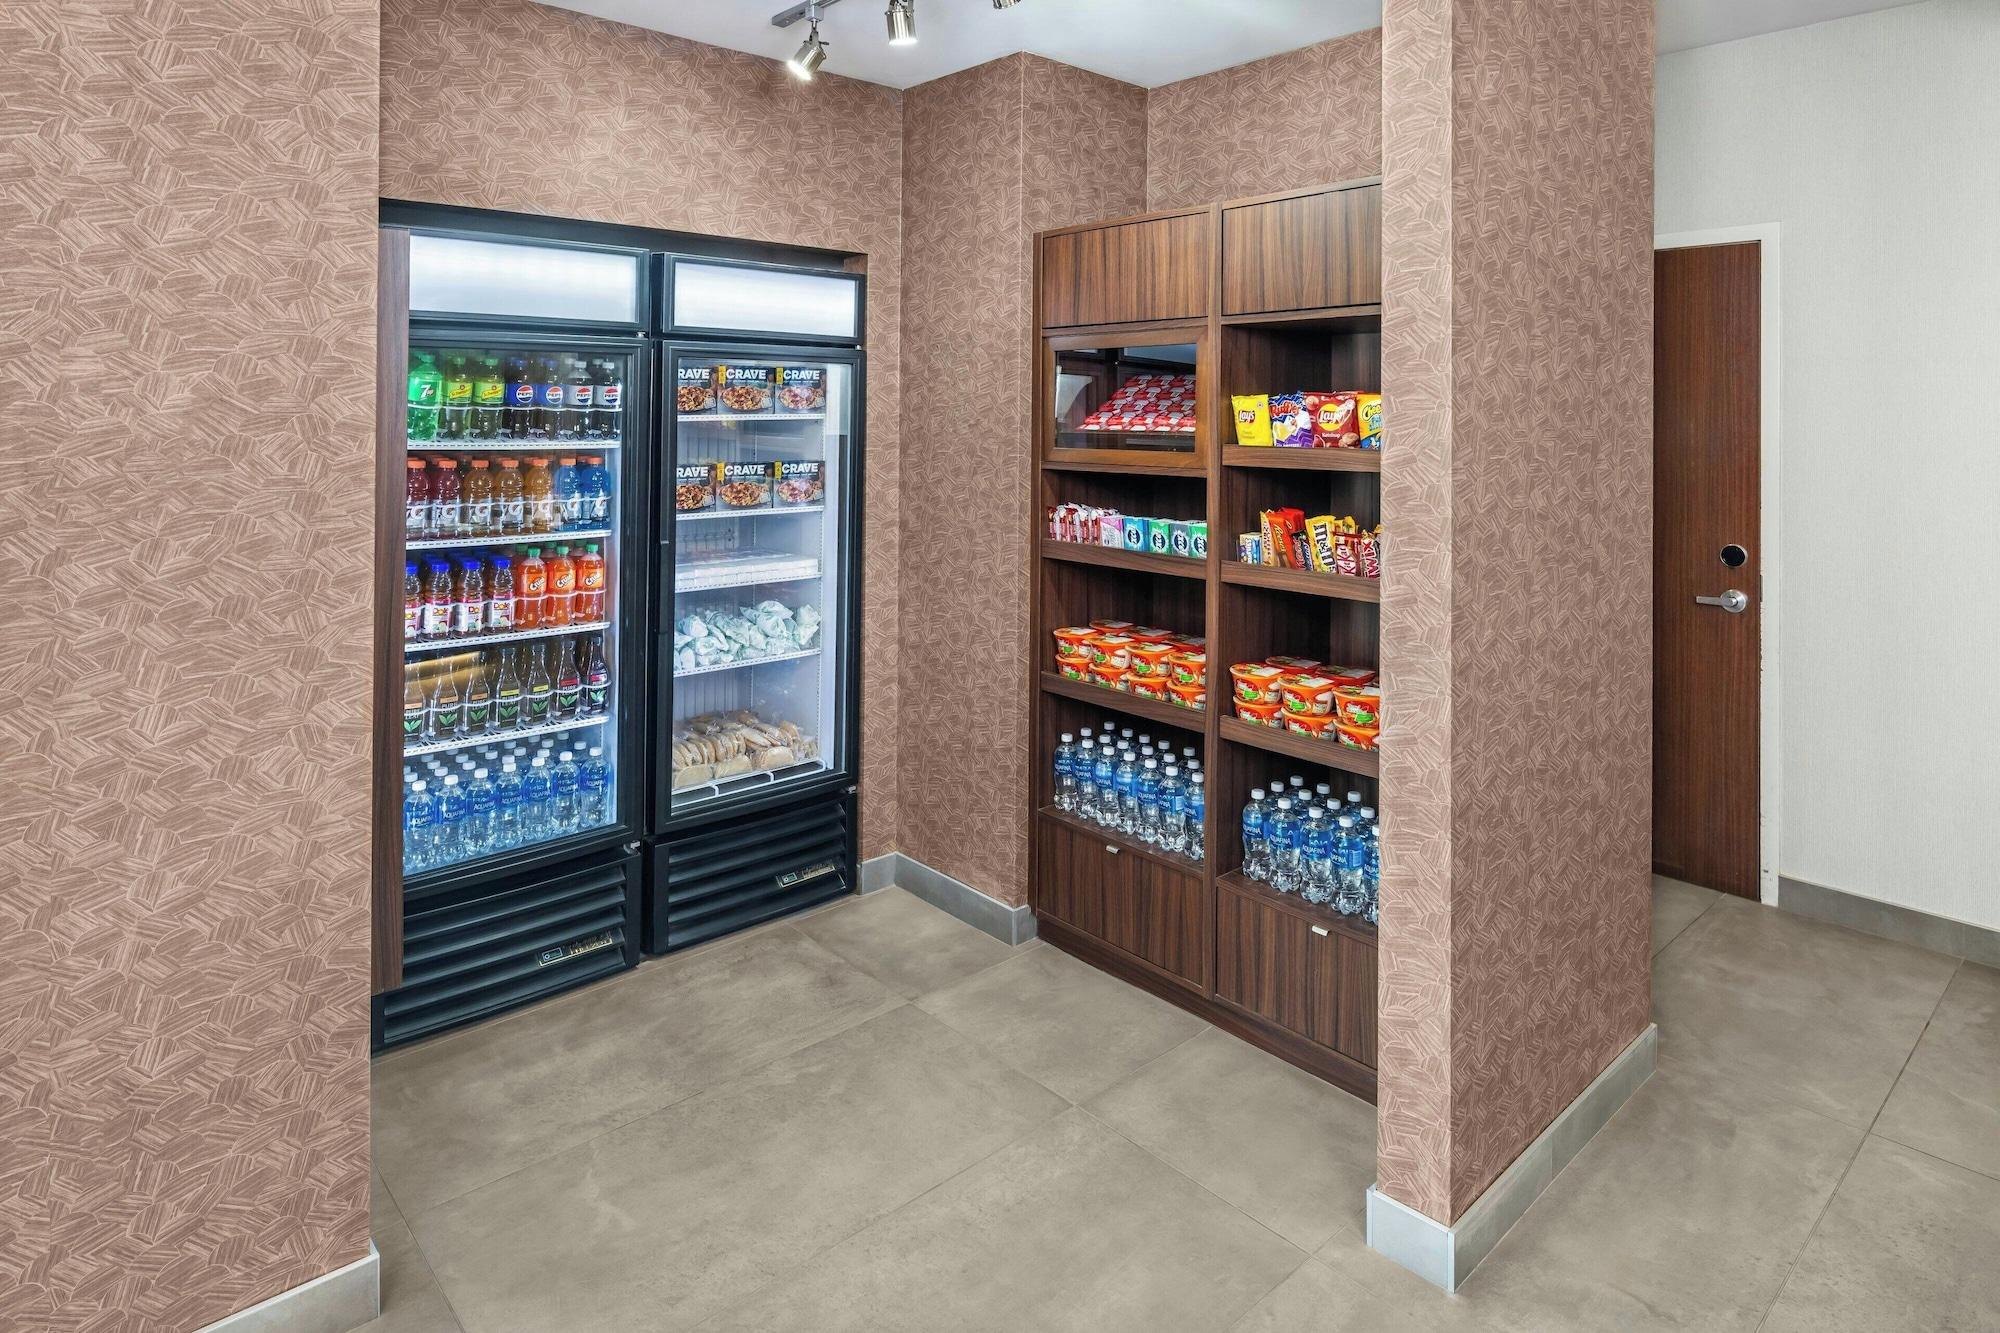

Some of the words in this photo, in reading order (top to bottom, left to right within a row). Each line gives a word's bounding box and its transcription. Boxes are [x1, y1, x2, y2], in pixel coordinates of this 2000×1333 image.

[726, 368, 767, 380] CRAVE
[783, 369, 820, 380] CRAVE
[724, 464, 765, 476] CRAVE
[781, 462, 819, 474] CRAVE
